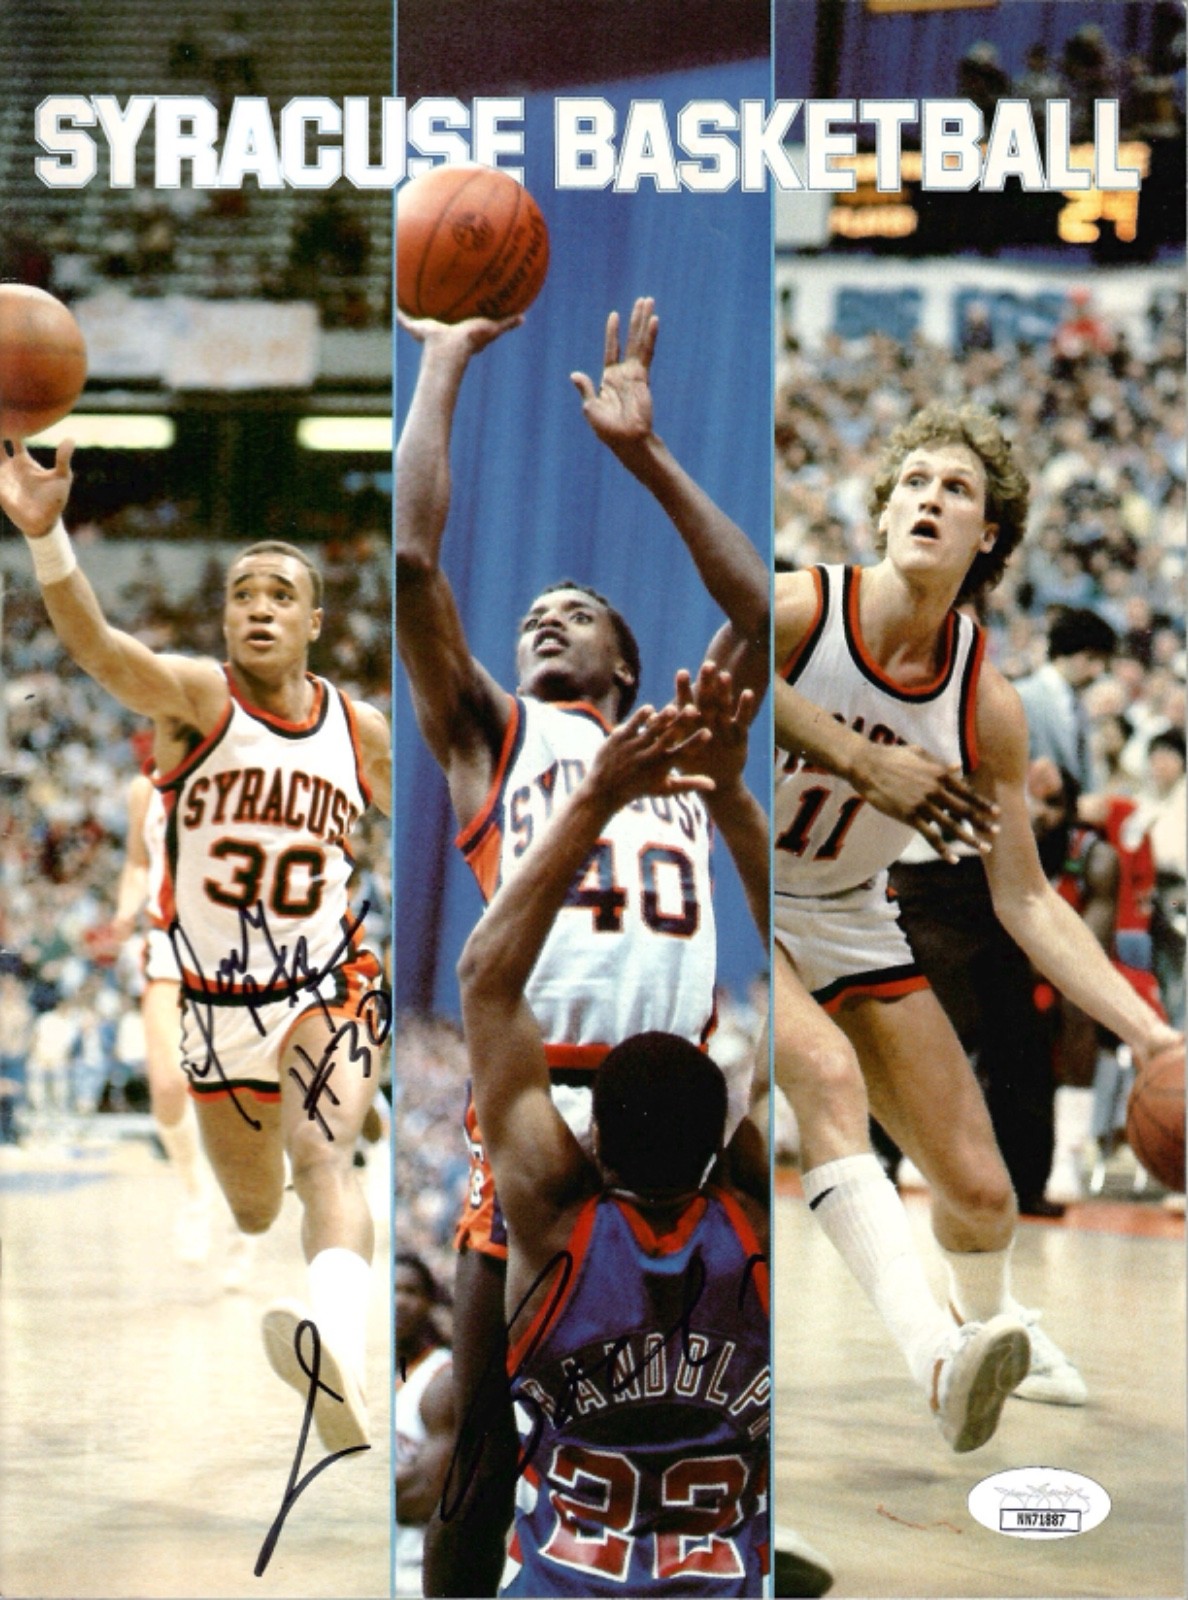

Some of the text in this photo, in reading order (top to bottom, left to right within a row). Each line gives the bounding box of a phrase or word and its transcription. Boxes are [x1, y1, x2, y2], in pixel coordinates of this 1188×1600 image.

[775, 785, 869, 862] 11
[203, 837, 326, 919] 30
[561, 837, 701, 940] 40
[539, 1444, 749, 1582] 22
